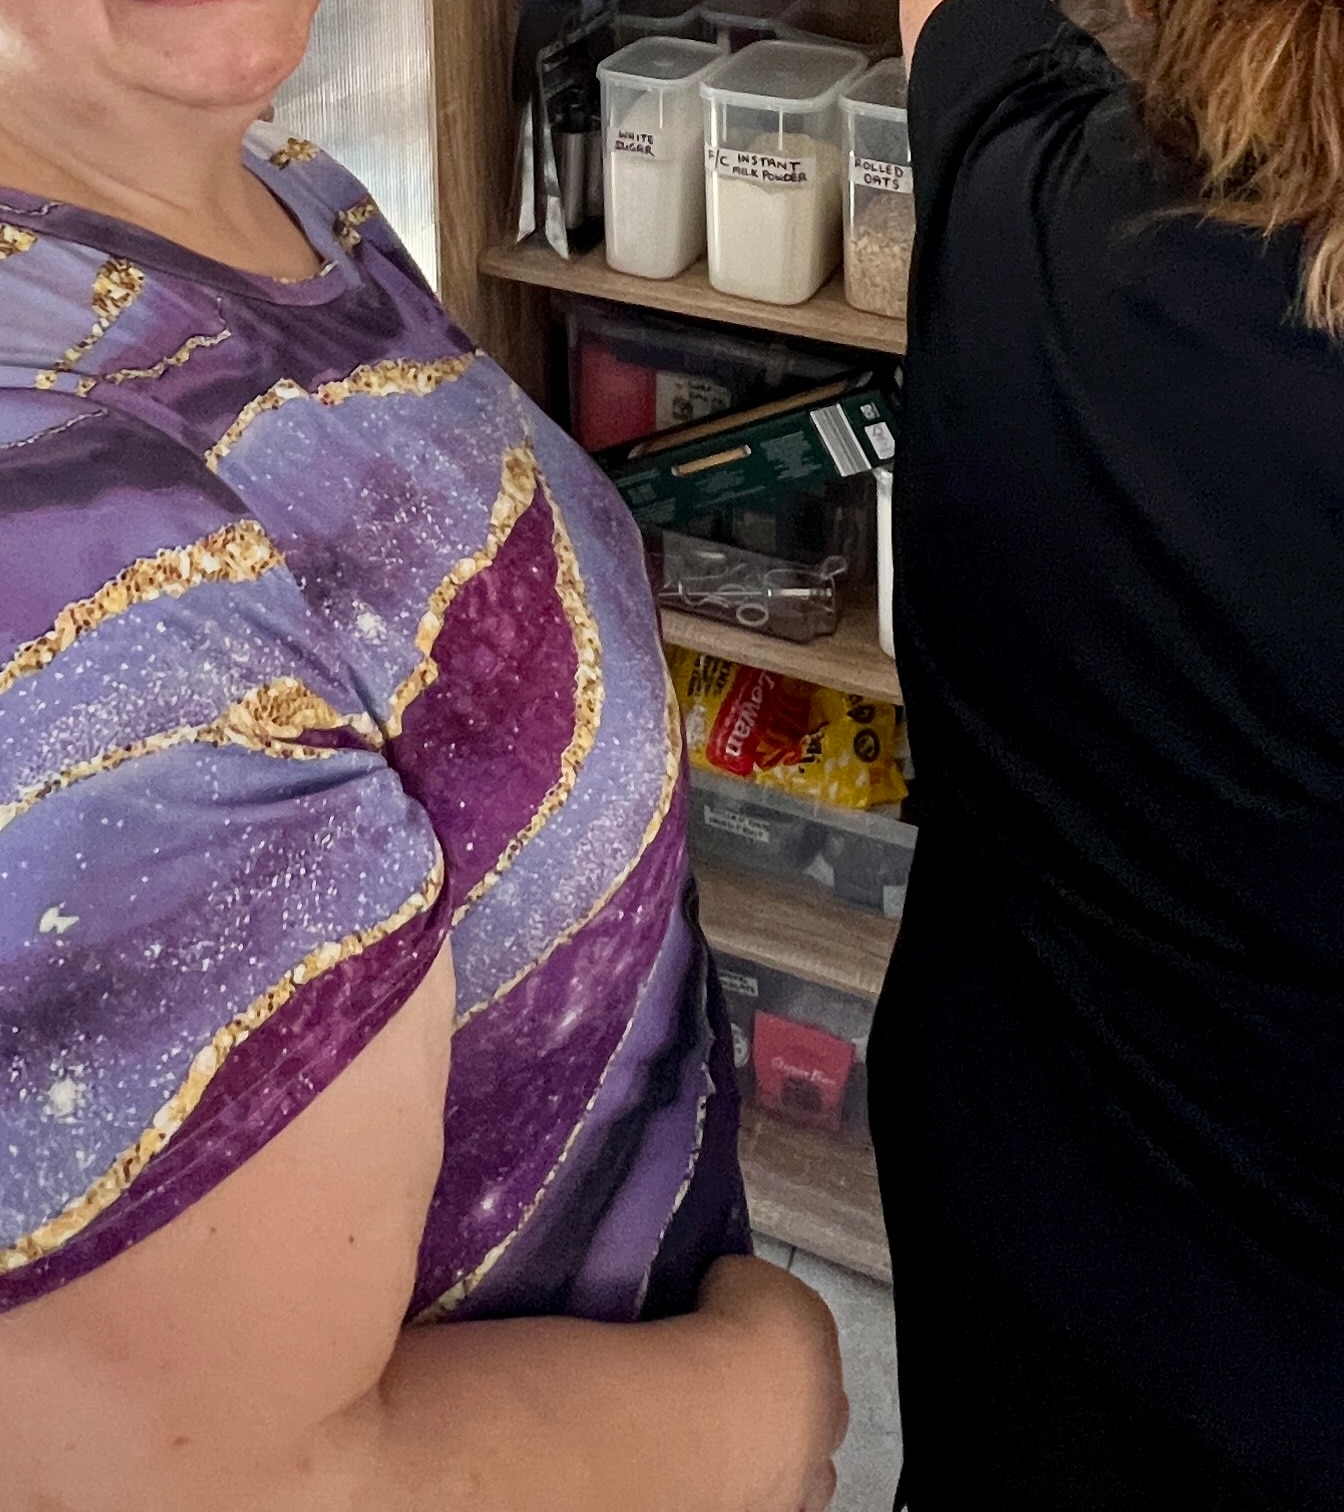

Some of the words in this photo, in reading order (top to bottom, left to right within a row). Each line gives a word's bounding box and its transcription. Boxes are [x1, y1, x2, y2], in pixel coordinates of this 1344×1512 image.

[618, 130, 654, 145] WHITE
[615, 140, 655, 157] SUGAR
[737, 153, 801, 171] INSTANT
[855, 159, 904, 178] ROLLED
[732, 166, 759, 178] MILK
[762, 169, 808, 182] POWDER
[864, 173, 900, 190] OATS
[725, 670, 776, 757] Lowan
